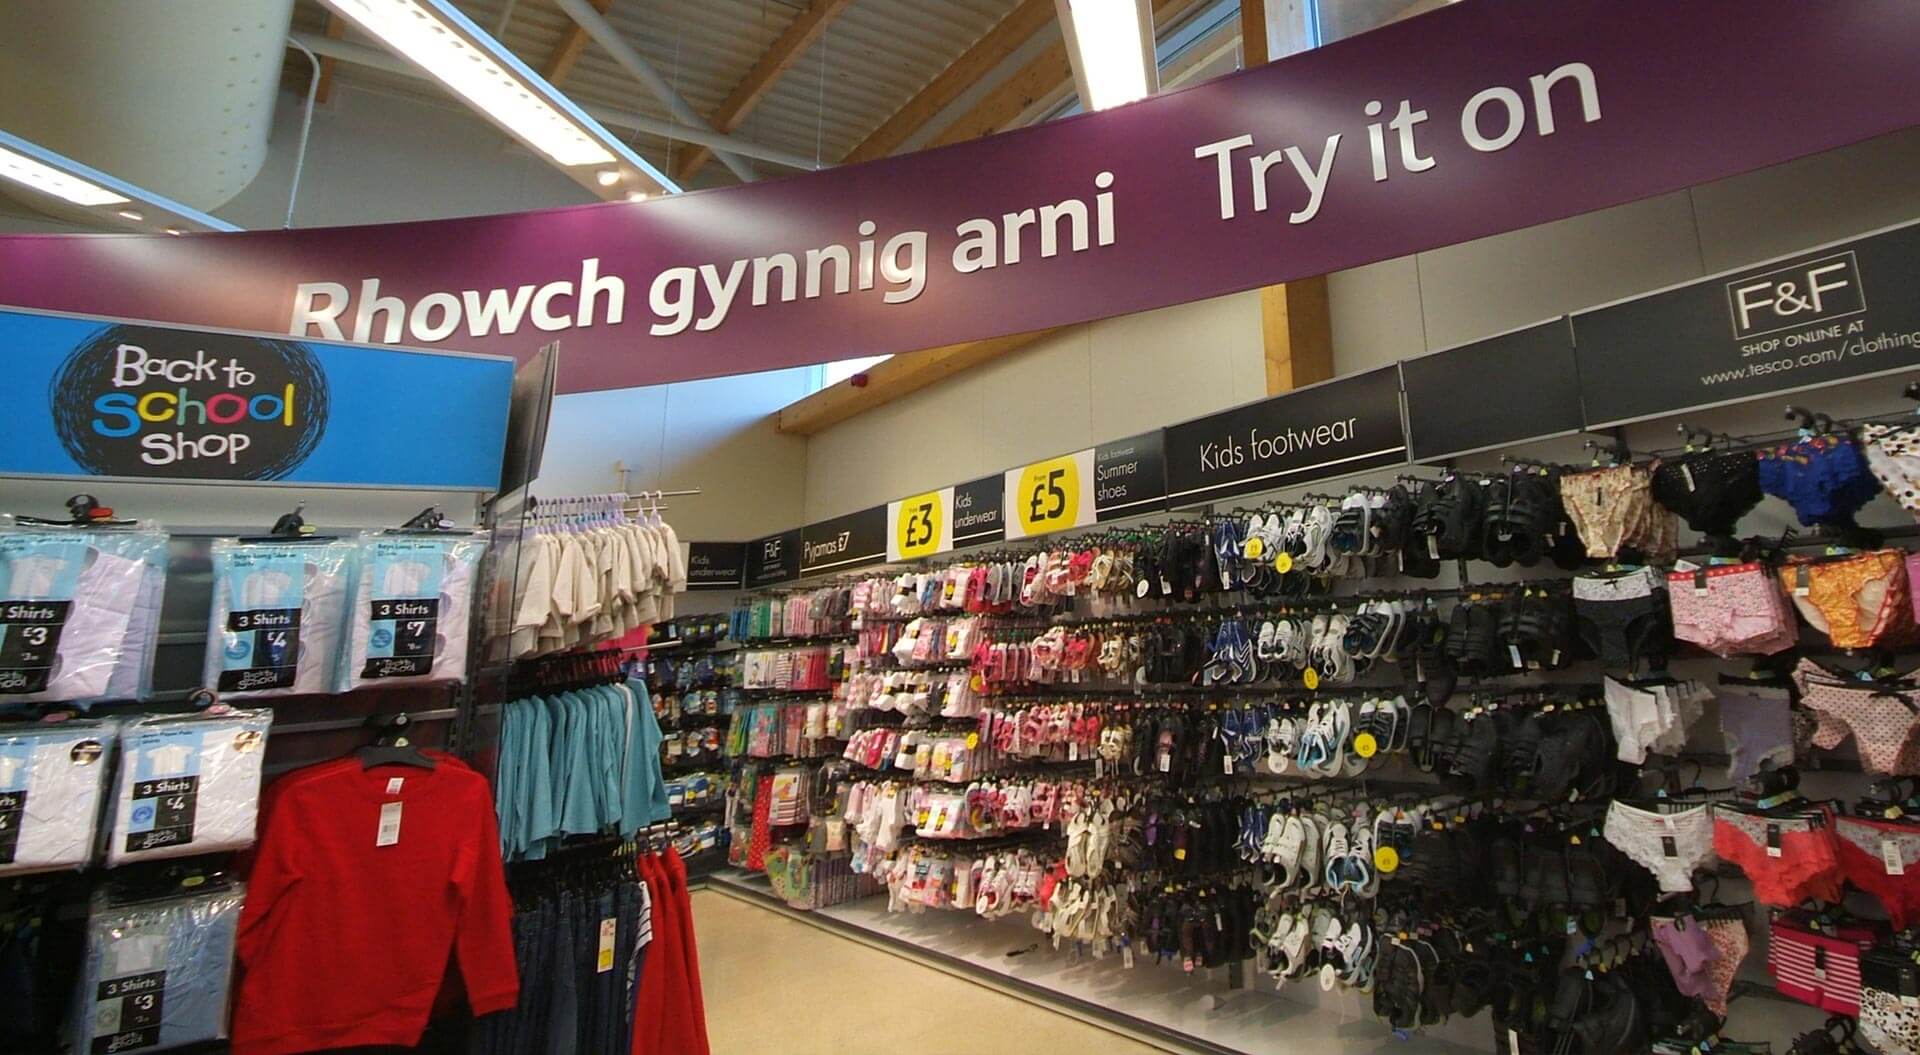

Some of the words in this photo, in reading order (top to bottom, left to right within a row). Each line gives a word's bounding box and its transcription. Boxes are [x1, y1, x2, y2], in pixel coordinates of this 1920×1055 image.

[1194, 133, 1342, 224] Try
[1364, 100, 1436, 182] it
[1461, 62, 1602, 152] on
[289, 258, 625, 343] Rhowch
[649, 220, 928, 336] gynnig
[952, 171, 1115, 273] arni
[1736, 261, 1848, 329] F&F
[1742, 338, 1780, 357] SHOP
[1784, 325, 1842, 348] ONLINE
[1847, 320, 1864, 334] AT
[112, 344, 216, 387] Back
[222, 358, 256, 388] to
[1701, 331, 1920, 385] www.tesco.com/clothing
[92, 383, 294, 437] School
[141, 432, 250, 464] Shop
[1200, 435, 1243, 472] Kids
[1251, 417, 1357, 461] footwear
[1096, 460, 1138, 481] Summer
[955, 495, 972, 510] Kids
[1030, 469, 1065, 523] £5
[1097, 483, 1127, 501] shoes
[905, 503, 933, 548] £3
[954, 510, 998, 529] underwear
[804, 540, 837, 563] Pyjamas
[838, 531, 850, 552] £7
[7, 606, 55, 619] Shirts
[239, 616, 249, 627] 3
[253, 613, 290, 625] Shirts
[380, 604, 390, 616] 3
[394, 603, 429, 615] Shirts
[23, 626, 48, 645] £3
[406, 621, 425, 637] £7
[143, 785, 153, 795] 3
[156, 781, 190, 793] Shirts
[107, 984, 117, 995] 3
[121, 979, 156, 993] Shirts
